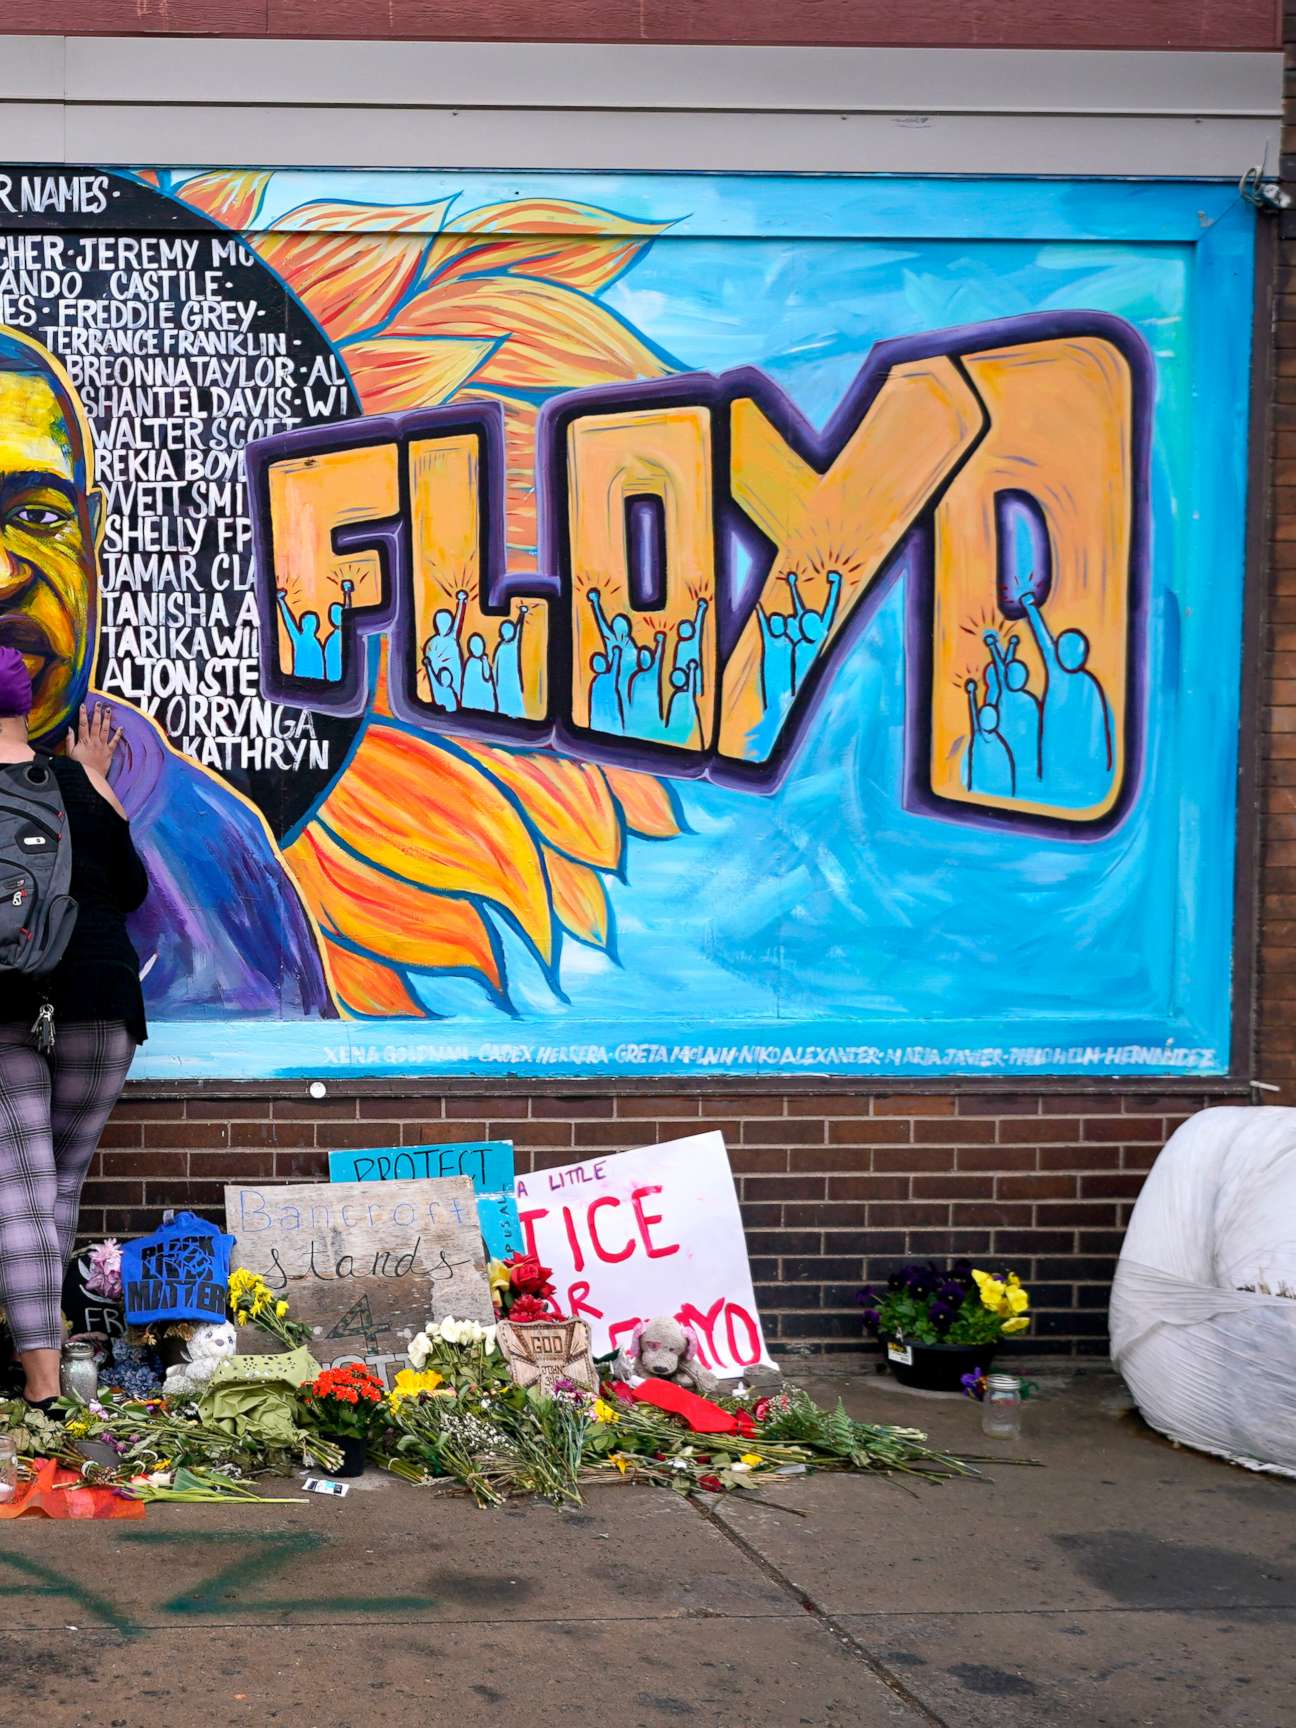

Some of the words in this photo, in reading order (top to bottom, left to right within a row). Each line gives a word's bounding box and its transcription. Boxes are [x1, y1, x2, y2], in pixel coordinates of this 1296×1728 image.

[21, 175, 109, 213] NAMES
[76, 237, 199, 272] JEREMY
[110, 271, 223, 301] CASTILE
[59, 300, 174, 329] FREDDIE
[181, 300, 257, 331] GREY
[39, 326, 158, 356] TERRANCE
[164, 329, 286, 356] FRANKLIN
[66, 355, 195, 387] BREONNA
[192, 356, 297, 388] TAYLOR
[83, 386, 207, 417] SHANTEL
[211, 387, 292, 417] DAVIS
[88, 416, 207, 450] WALTER
[95, 449, 178, 482] REKIA
[98, 481, 187, 516] YVETT
[104, 514, 207, 555] SHELLY
[98, 553, 204, 592] JAMAR
[266, 336, 1132, 822] FLOYD
[101, 591, 230, 627] TANISHA
[101, 625, 211, 660] TARIKA
[102, 657, 199, 699] ALTON
[182, 737, 329, 771] KATHRYN
[548, 1161, 607, 1191] LITTLE
[240, 1190, 466, 1232] Bancroft
[531, 1335, 563, 1354] GOD
